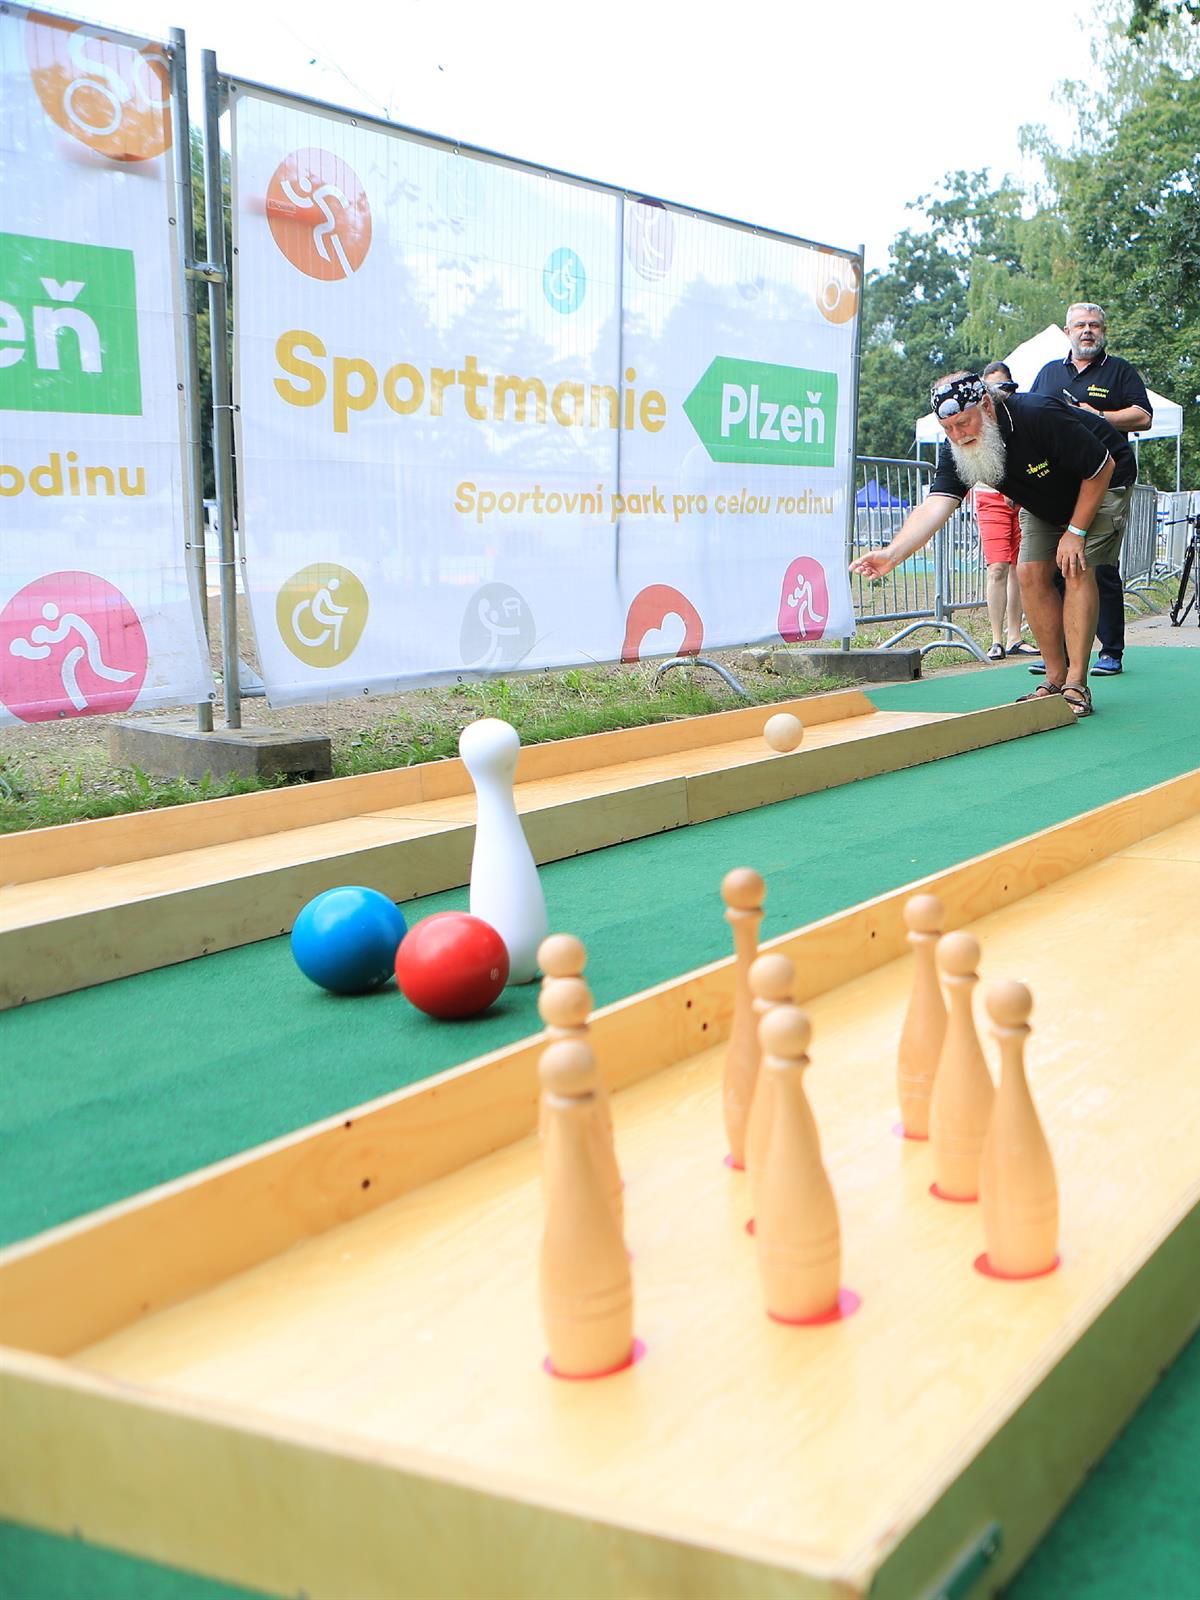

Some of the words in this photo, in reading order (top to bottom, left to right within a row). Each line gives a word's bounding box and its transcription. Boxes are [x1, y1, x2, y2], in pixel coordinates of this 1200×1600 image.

[273, 329, 667, 433] Sportmanie
[721, 384, 825, 444] Plzeň
[0, 451, 146, 497] odinu
[454, 482, 604, 523] Sportovní
[611, 486, 668, 523] park
[672, 493, 709, 522] pro
[715, 488, 771, 515] celou
[776, 489, 834, 515] rodinu
